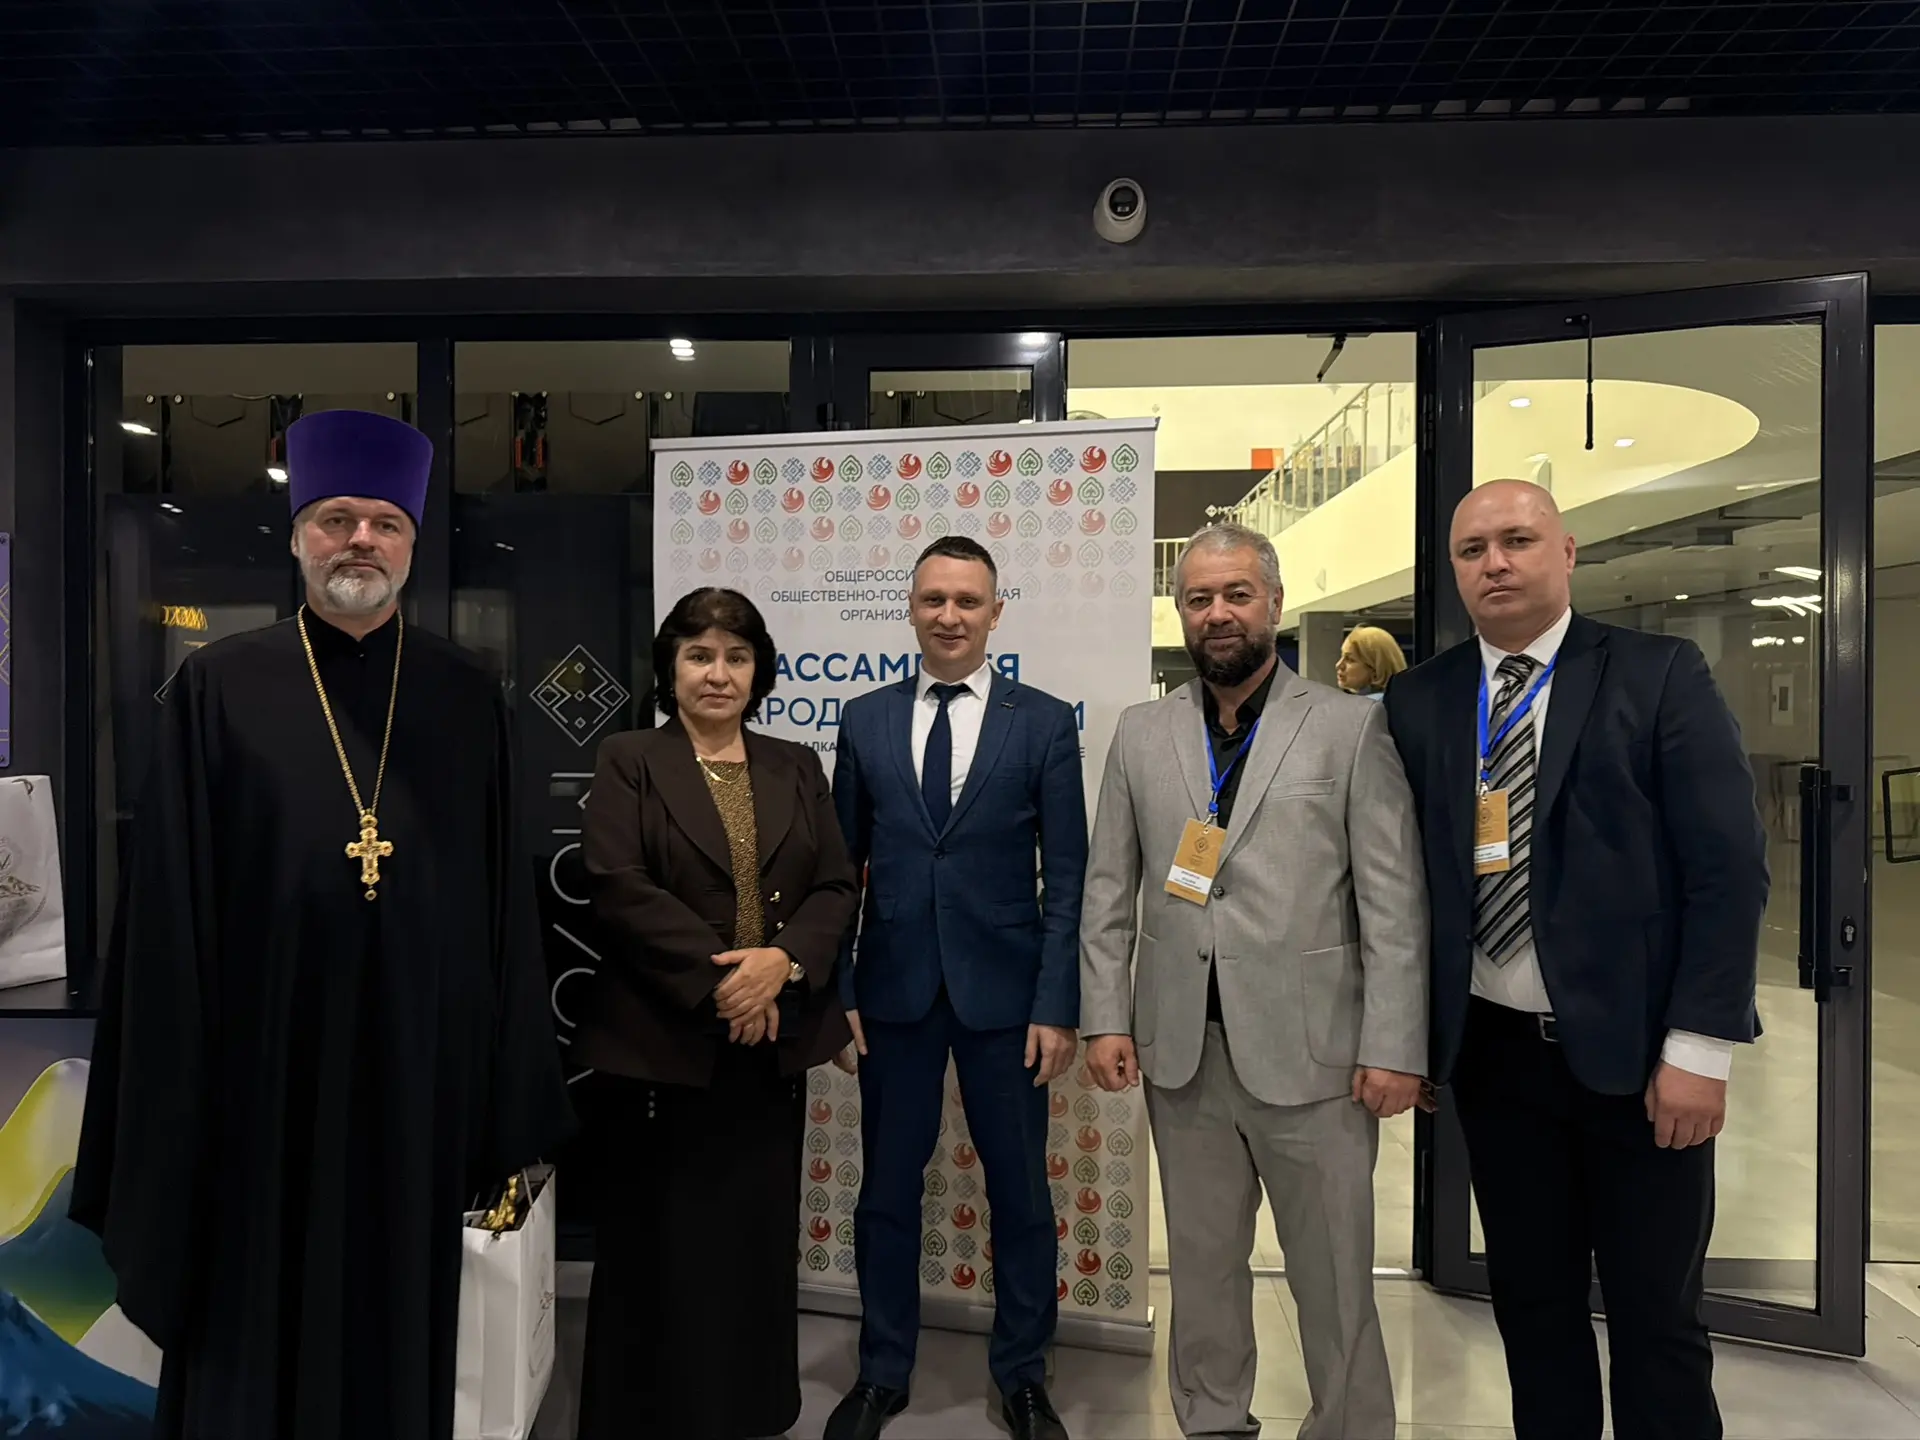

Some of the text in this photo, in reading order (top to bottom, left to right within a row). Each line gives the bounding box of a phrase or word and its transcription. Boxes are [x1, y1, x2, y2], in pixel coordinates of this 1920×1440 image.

[824, 569, 914, 583] ОБЩЕРОССИ
[840, 609, 911, 621] ОРГАНИЗА
[776, 652, 1019, 682] АССАМЯ
